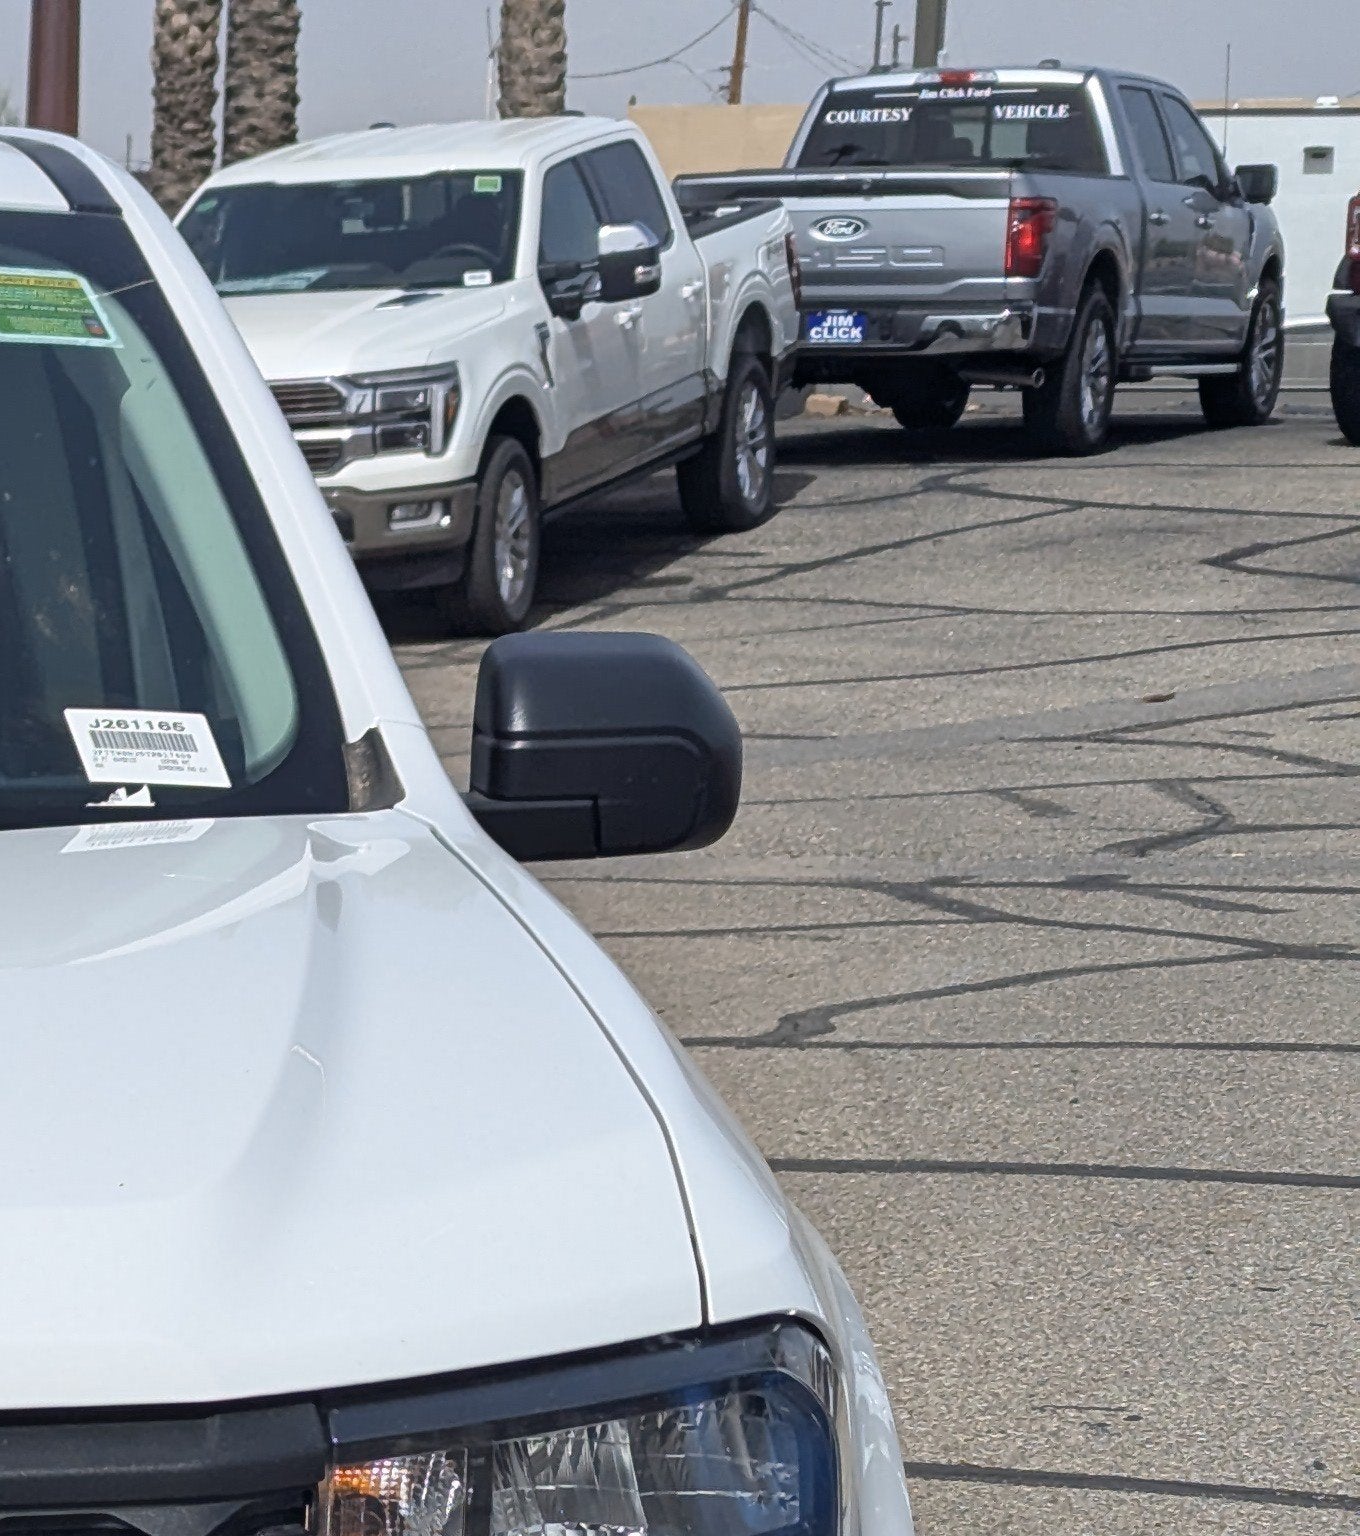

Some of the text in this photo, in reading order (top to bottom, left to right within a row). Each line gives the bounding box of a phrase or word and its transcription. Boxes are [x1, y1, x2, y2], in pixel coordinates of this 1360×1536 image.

[939, 87, 965, 99] Click
[966, 86, 992, 98] Ford
[824, 104, 1070, 124] COURTESY VEHICLE
[824, 220, 856, 235] Ford
[822, 315, 854, 327] JIM
[809, 326, 863, 339] CLICK
